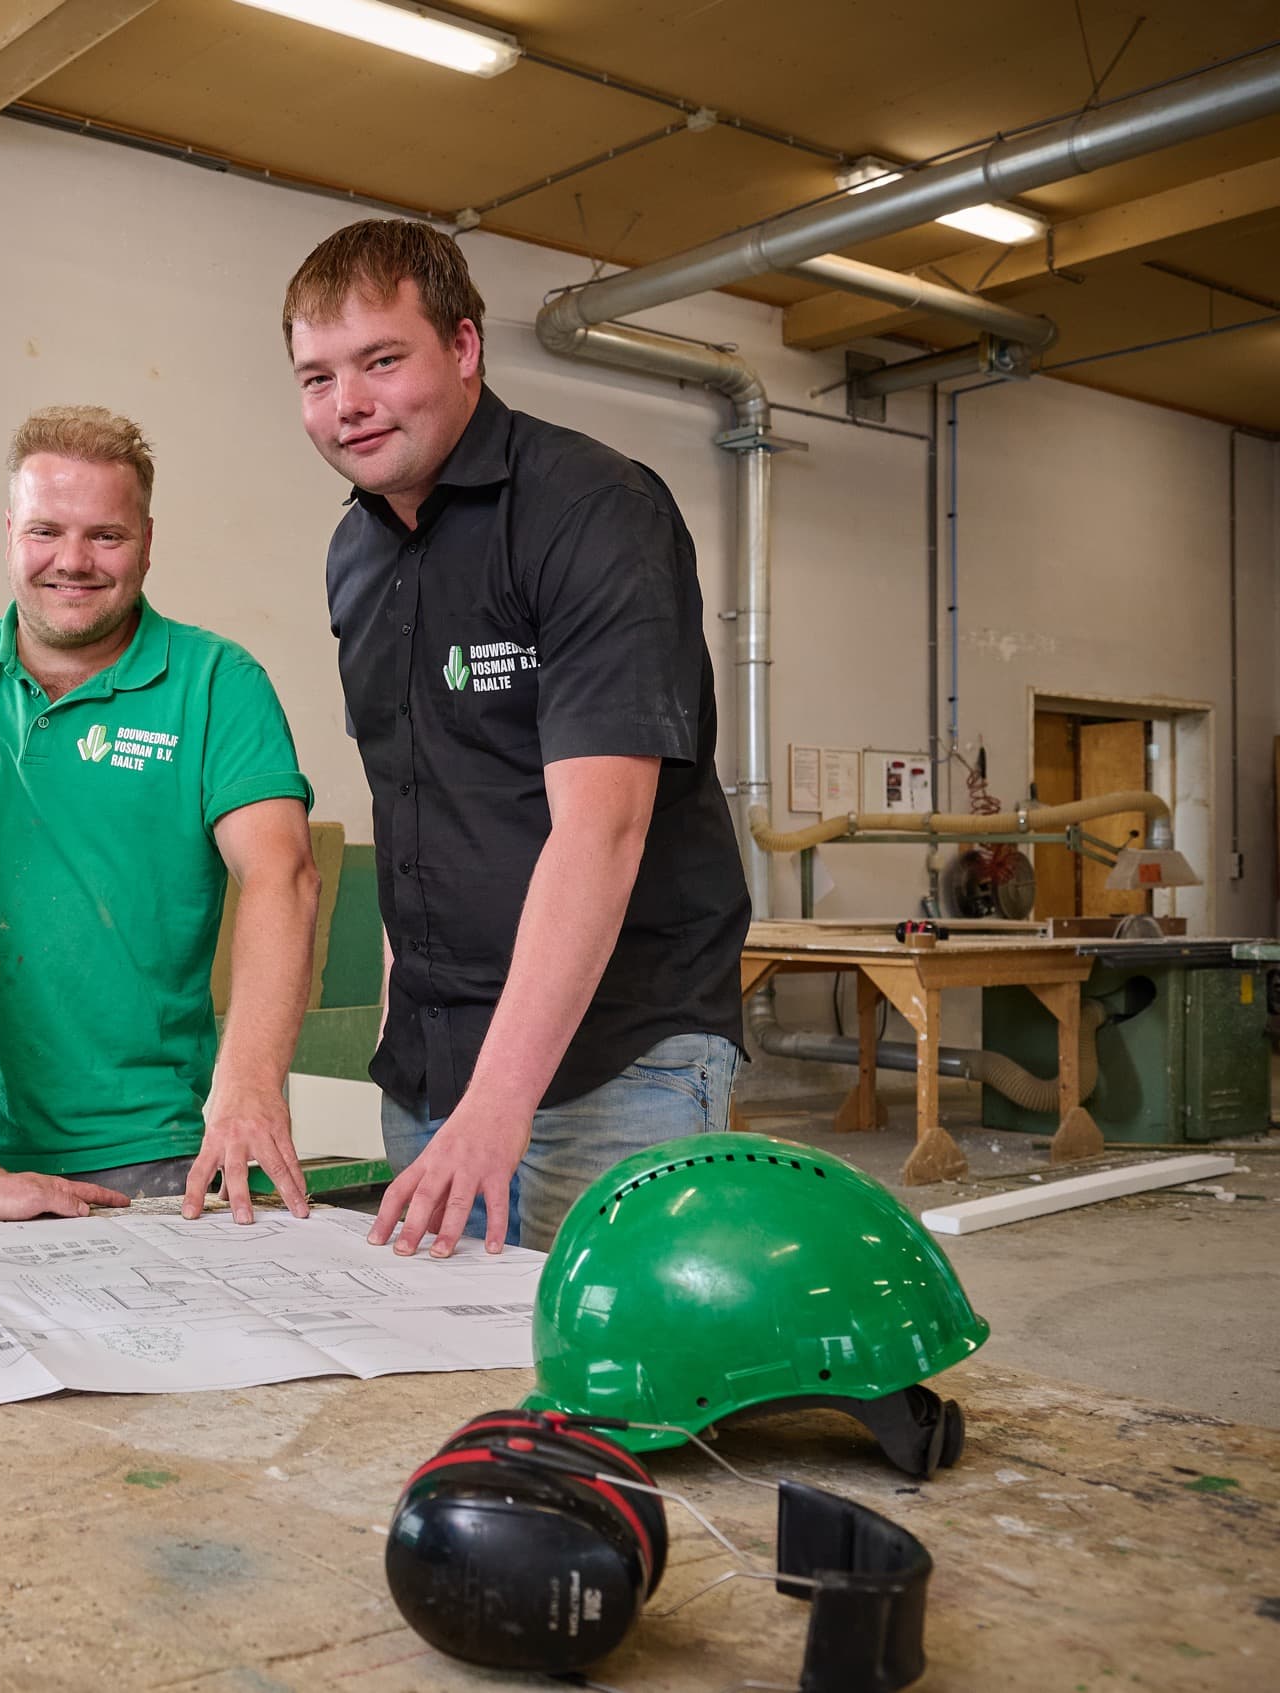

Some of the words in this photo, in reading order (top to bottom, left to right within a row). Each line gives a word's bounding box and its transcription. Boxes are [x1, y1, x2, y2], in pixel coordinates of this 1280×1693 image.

[471, 658, 515, 676] VOSMAN
[520, 656, 541, 670] B.V.
[473, 676, 511, 692] RAALTE
[117, 727, 179, 748] BOUWBEDRIJF
[114, 740, 153, 758] VOSMAN
[156, 747, 174, 762] B.V.
[110, 754, 145, 771] RAALTE
